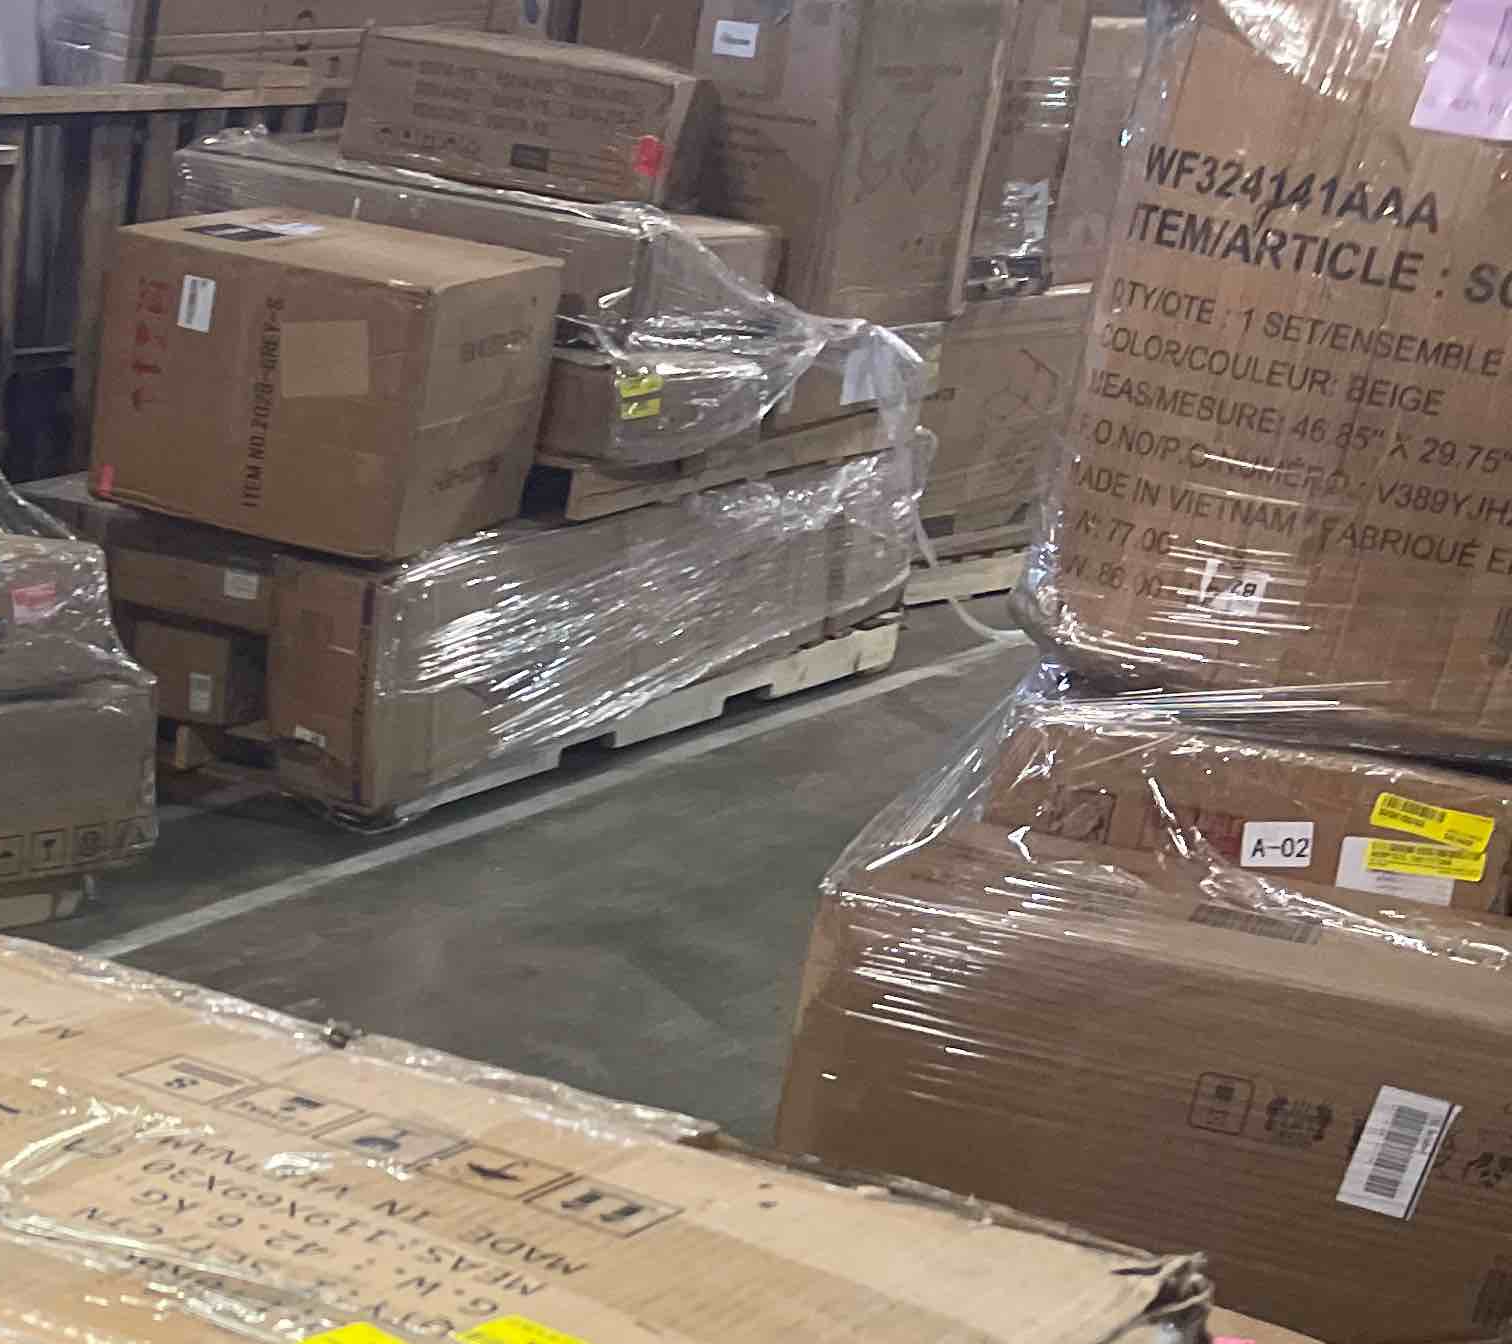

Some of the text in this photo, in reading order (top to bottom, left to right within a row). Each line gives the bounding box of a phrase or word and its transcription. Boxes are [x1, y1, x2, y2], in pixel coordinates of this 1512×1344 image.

[1144, 145, 1438, 234] WF324141AAA
[1128, 203, 1424, 293] ITEM/ARTICLE
[1263, 311, 1504, 377] SET/ENSEMBLE
[1347, 373, 1445, 416] BEIGE
[1251, 838, 1310, 858] A-02
